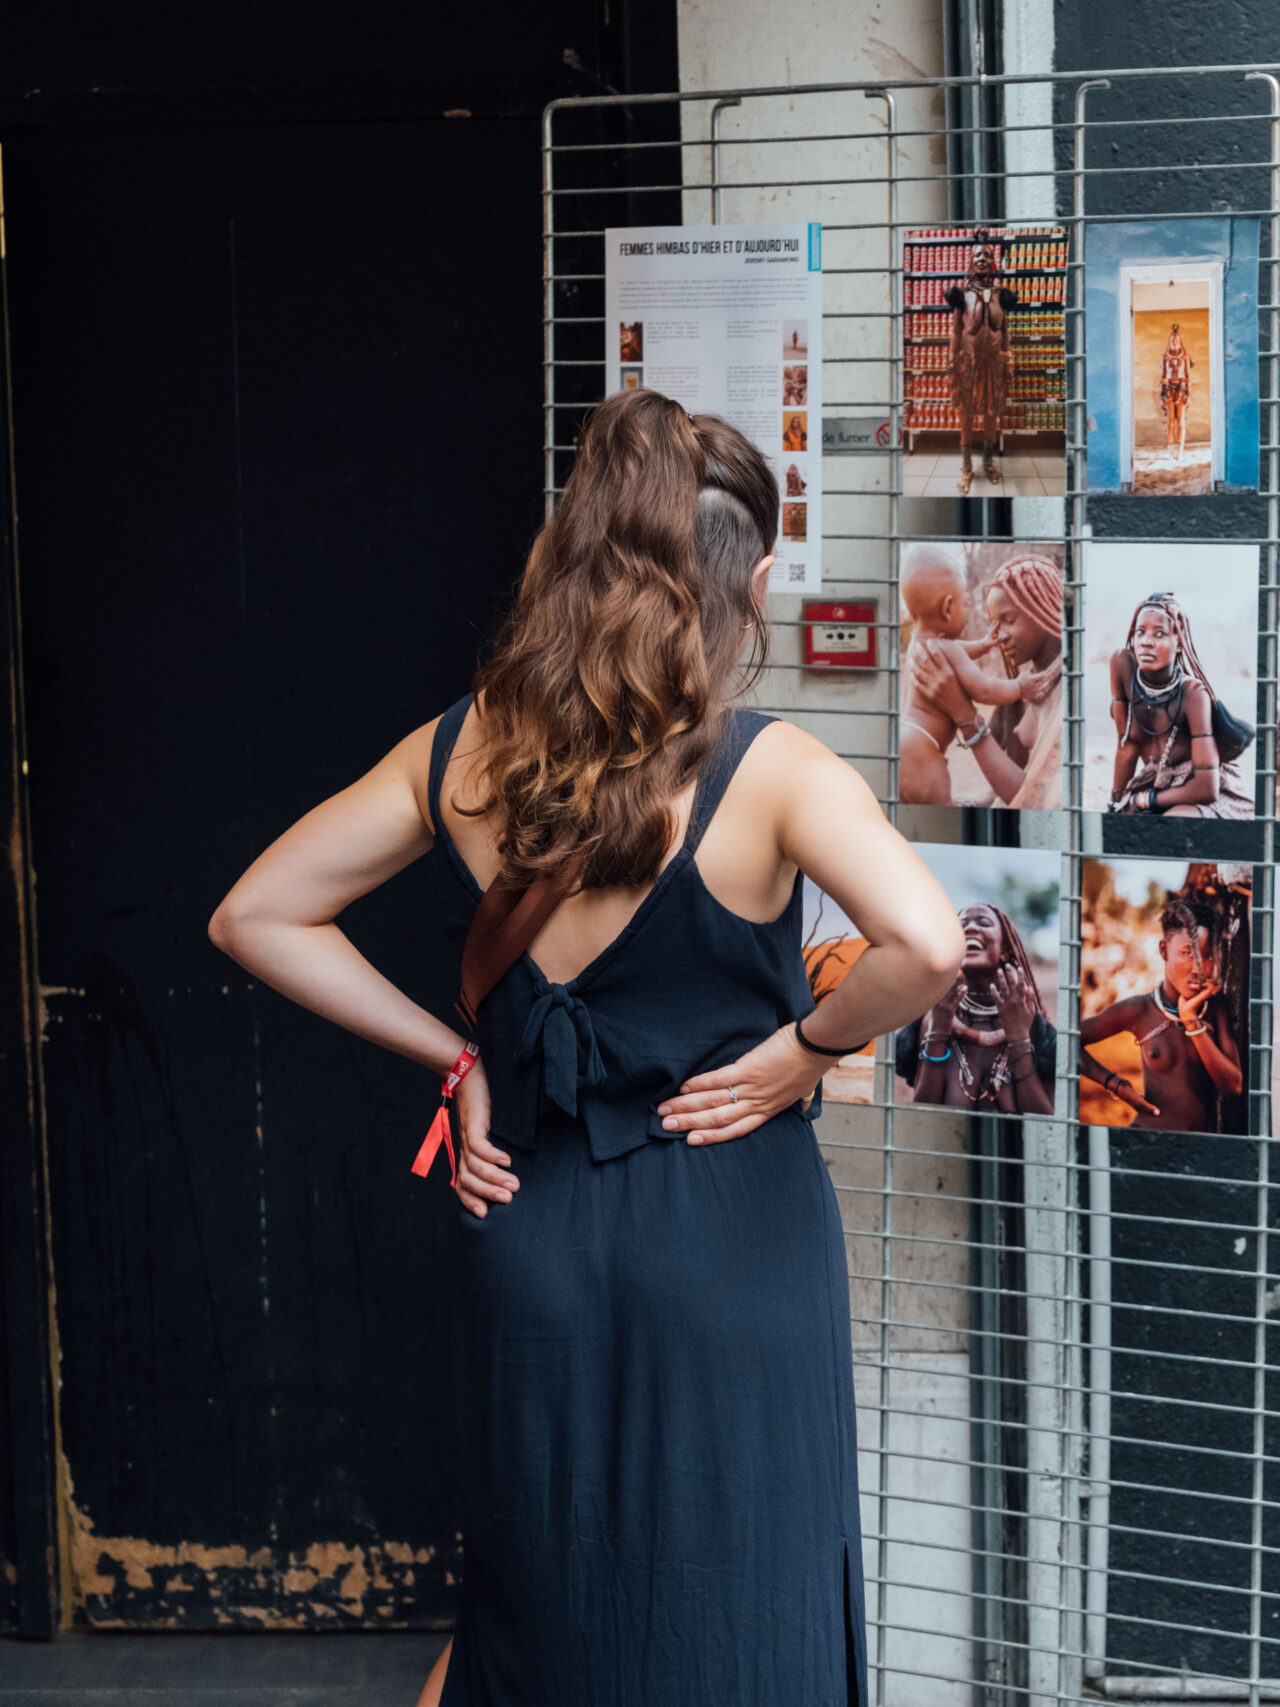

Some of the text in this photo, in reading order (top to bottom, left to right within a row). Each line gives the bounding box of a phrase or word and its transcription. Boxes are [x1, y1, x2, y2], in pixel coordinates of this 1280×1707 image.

[619, 238, 799, 256] FEMMES HIMBAS D'HIER ET D'AUJOURD'HUI
